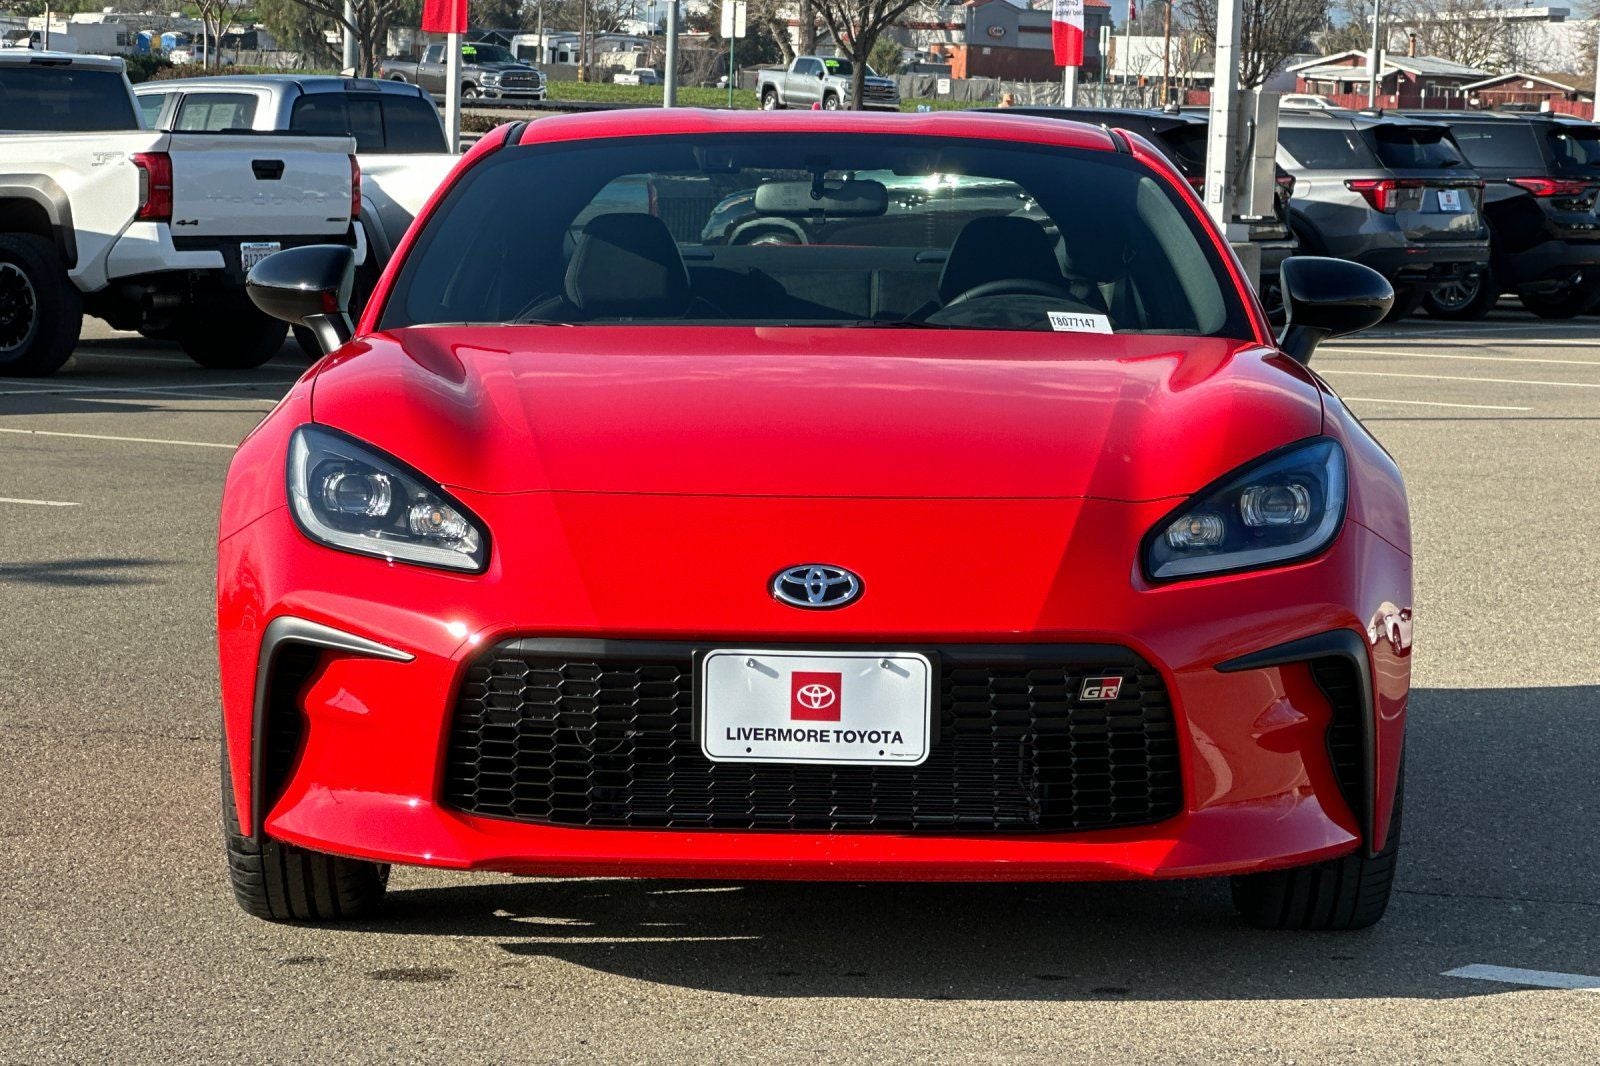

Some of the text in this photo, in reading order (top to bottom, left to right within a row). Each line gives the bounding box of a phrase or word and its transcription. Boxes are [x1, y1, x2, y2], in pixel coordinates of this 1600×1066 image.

[1050, 316, 1095, 328] T8077147
[1083, 686, 1118, 698] GR
[726, 727, 904, 744] LIVERMORE TOYOTA
